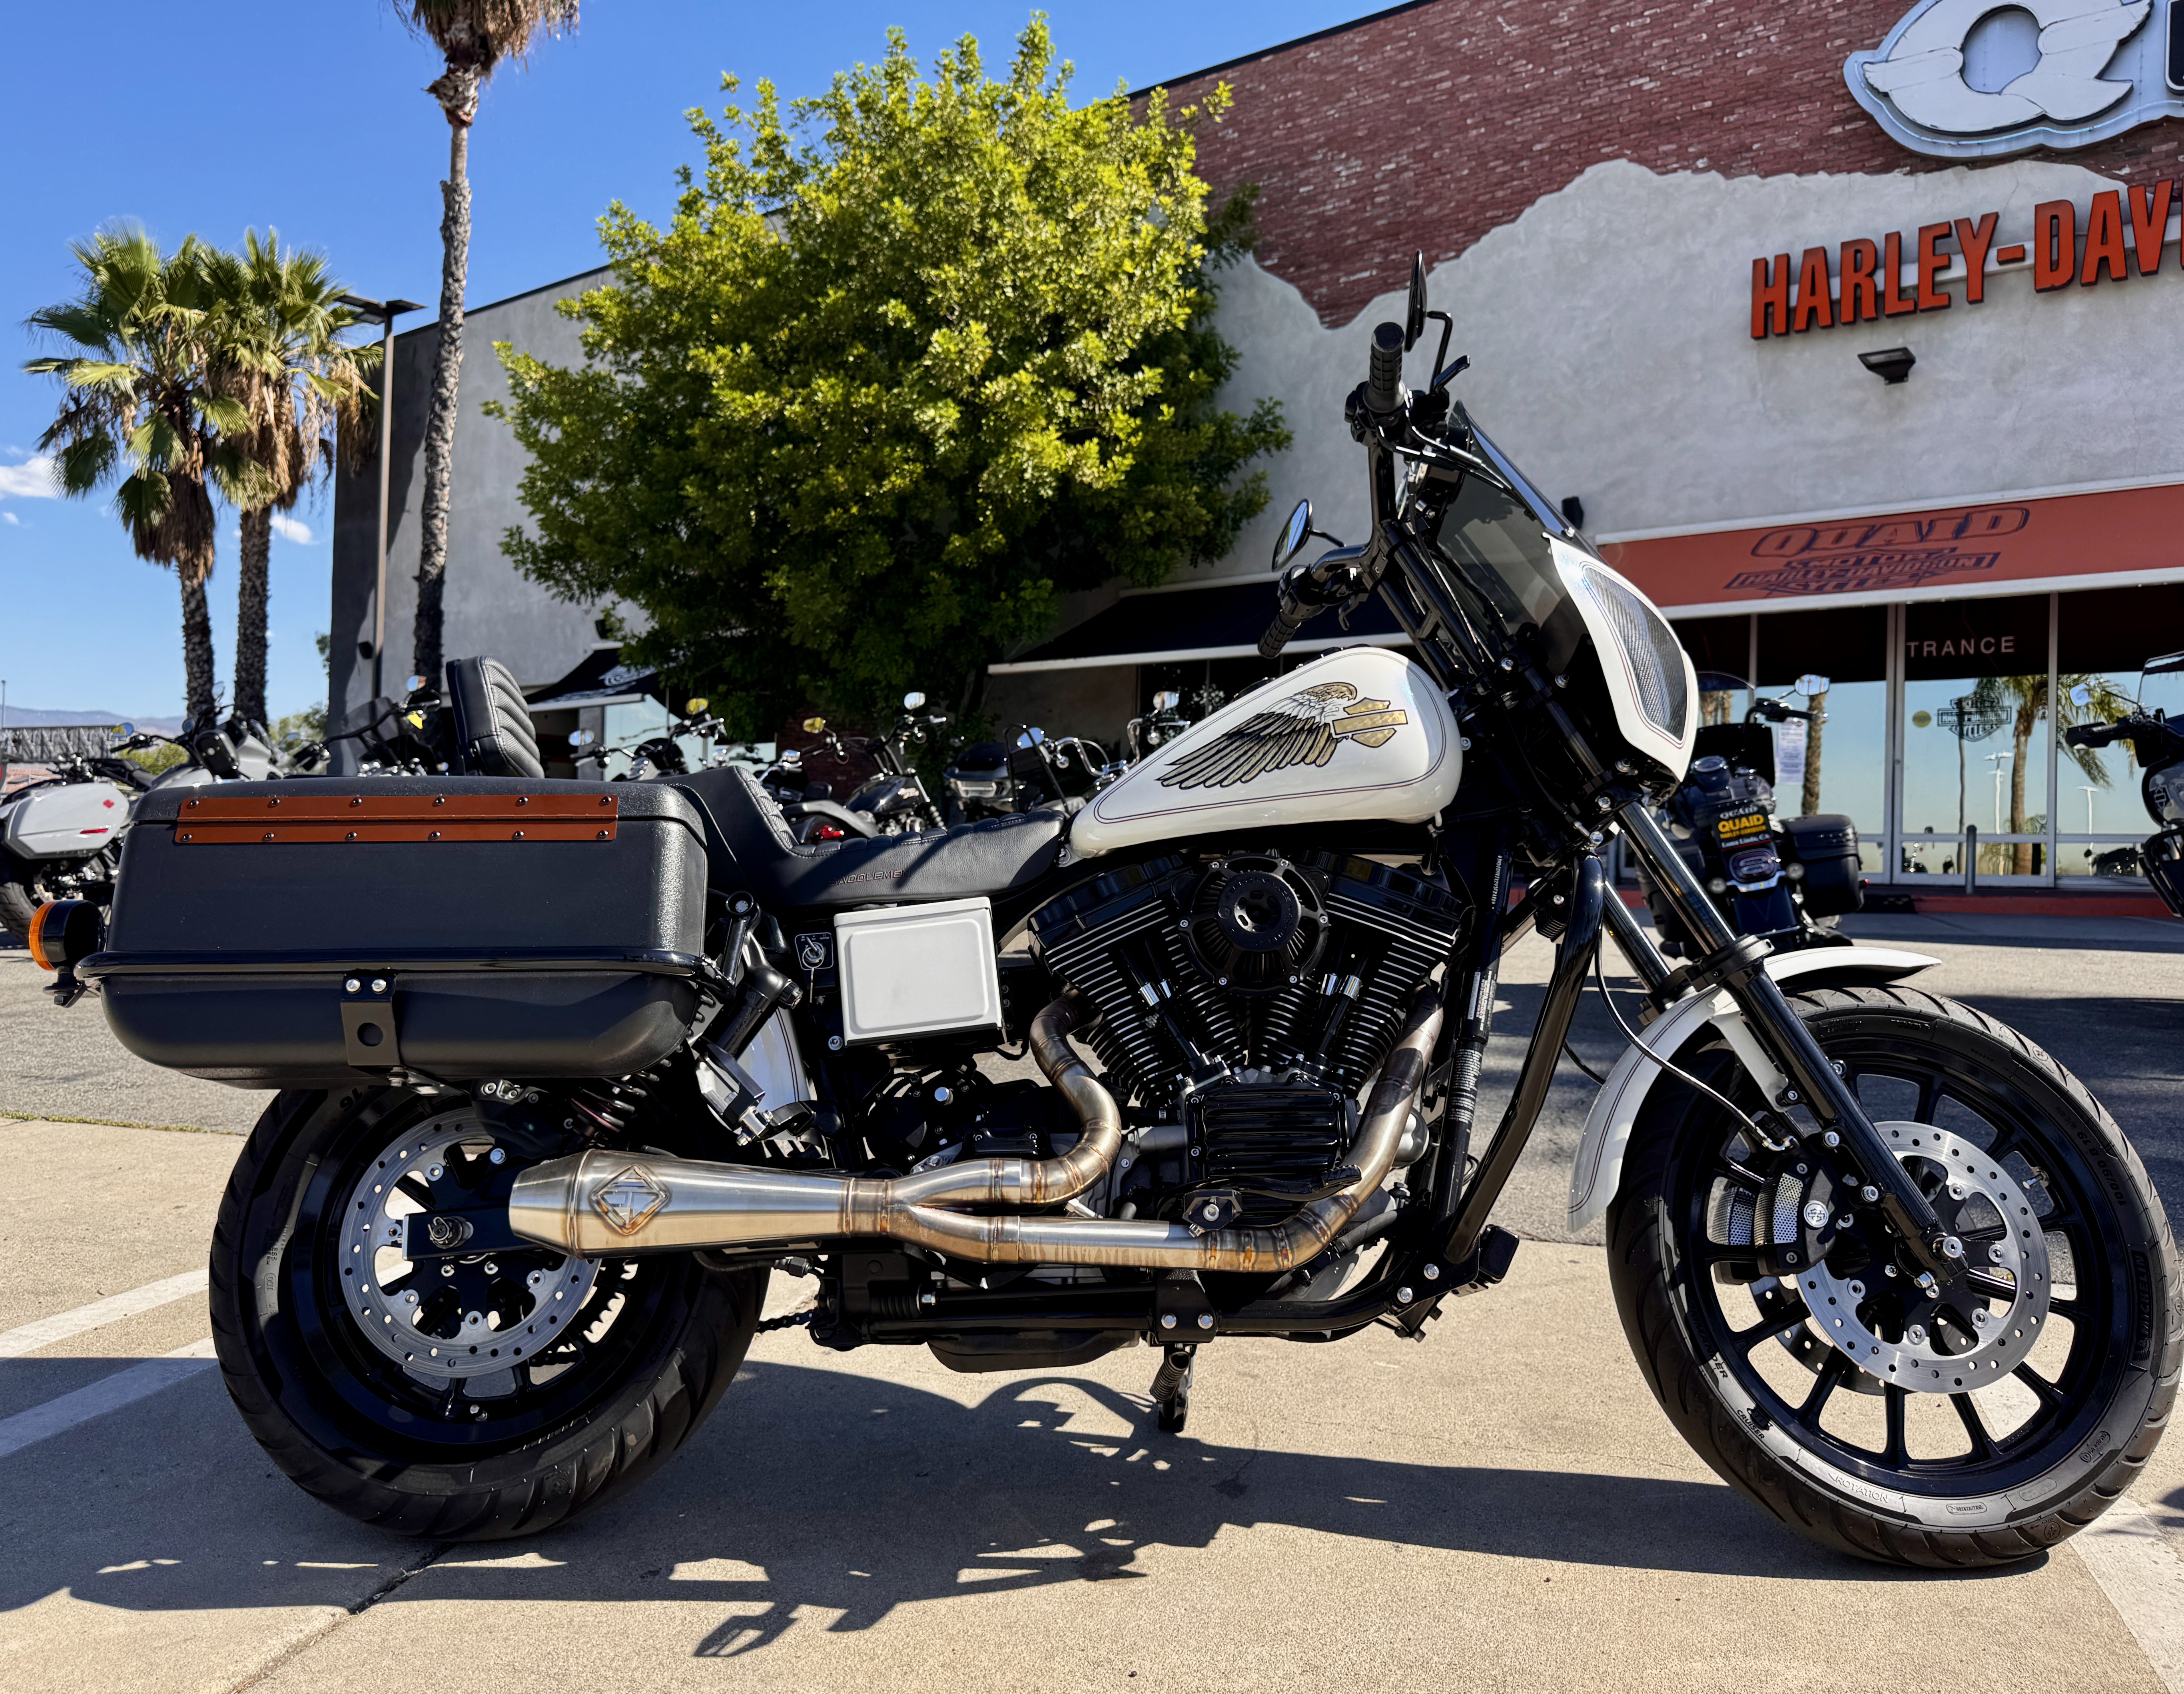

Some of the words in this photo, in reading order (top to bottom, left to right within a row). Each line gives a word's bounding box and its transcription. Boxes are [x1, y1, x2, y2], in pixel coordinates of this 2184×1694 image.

[1751, 178, 2184, 340] HARLEY-DAV
[1751, 508, 2030, 557] QUAID
[1906, 636, 2015, 658] TRANCE
[1718, 814, 1764, 833] QUAID
[828, 869, 911, 887] SADDLEMEN
[340, 1088, 362, 1112] 16
[2077, 1132, 2091, 1145] 19
[2088, 1148, 2100, 1156] B
[2097, 1160, 2127, 1206] 100/90
[2134, 1254, 2150, 1335] MICHELIN
[649, 1317, 678, 1364] CRUISER
[1686, 1292, 1728, 1378] COMMANDER
[1737, 1409, 1765, 1439] CRUISER
[1835, 1477, 1888, 1503] ROTATION
